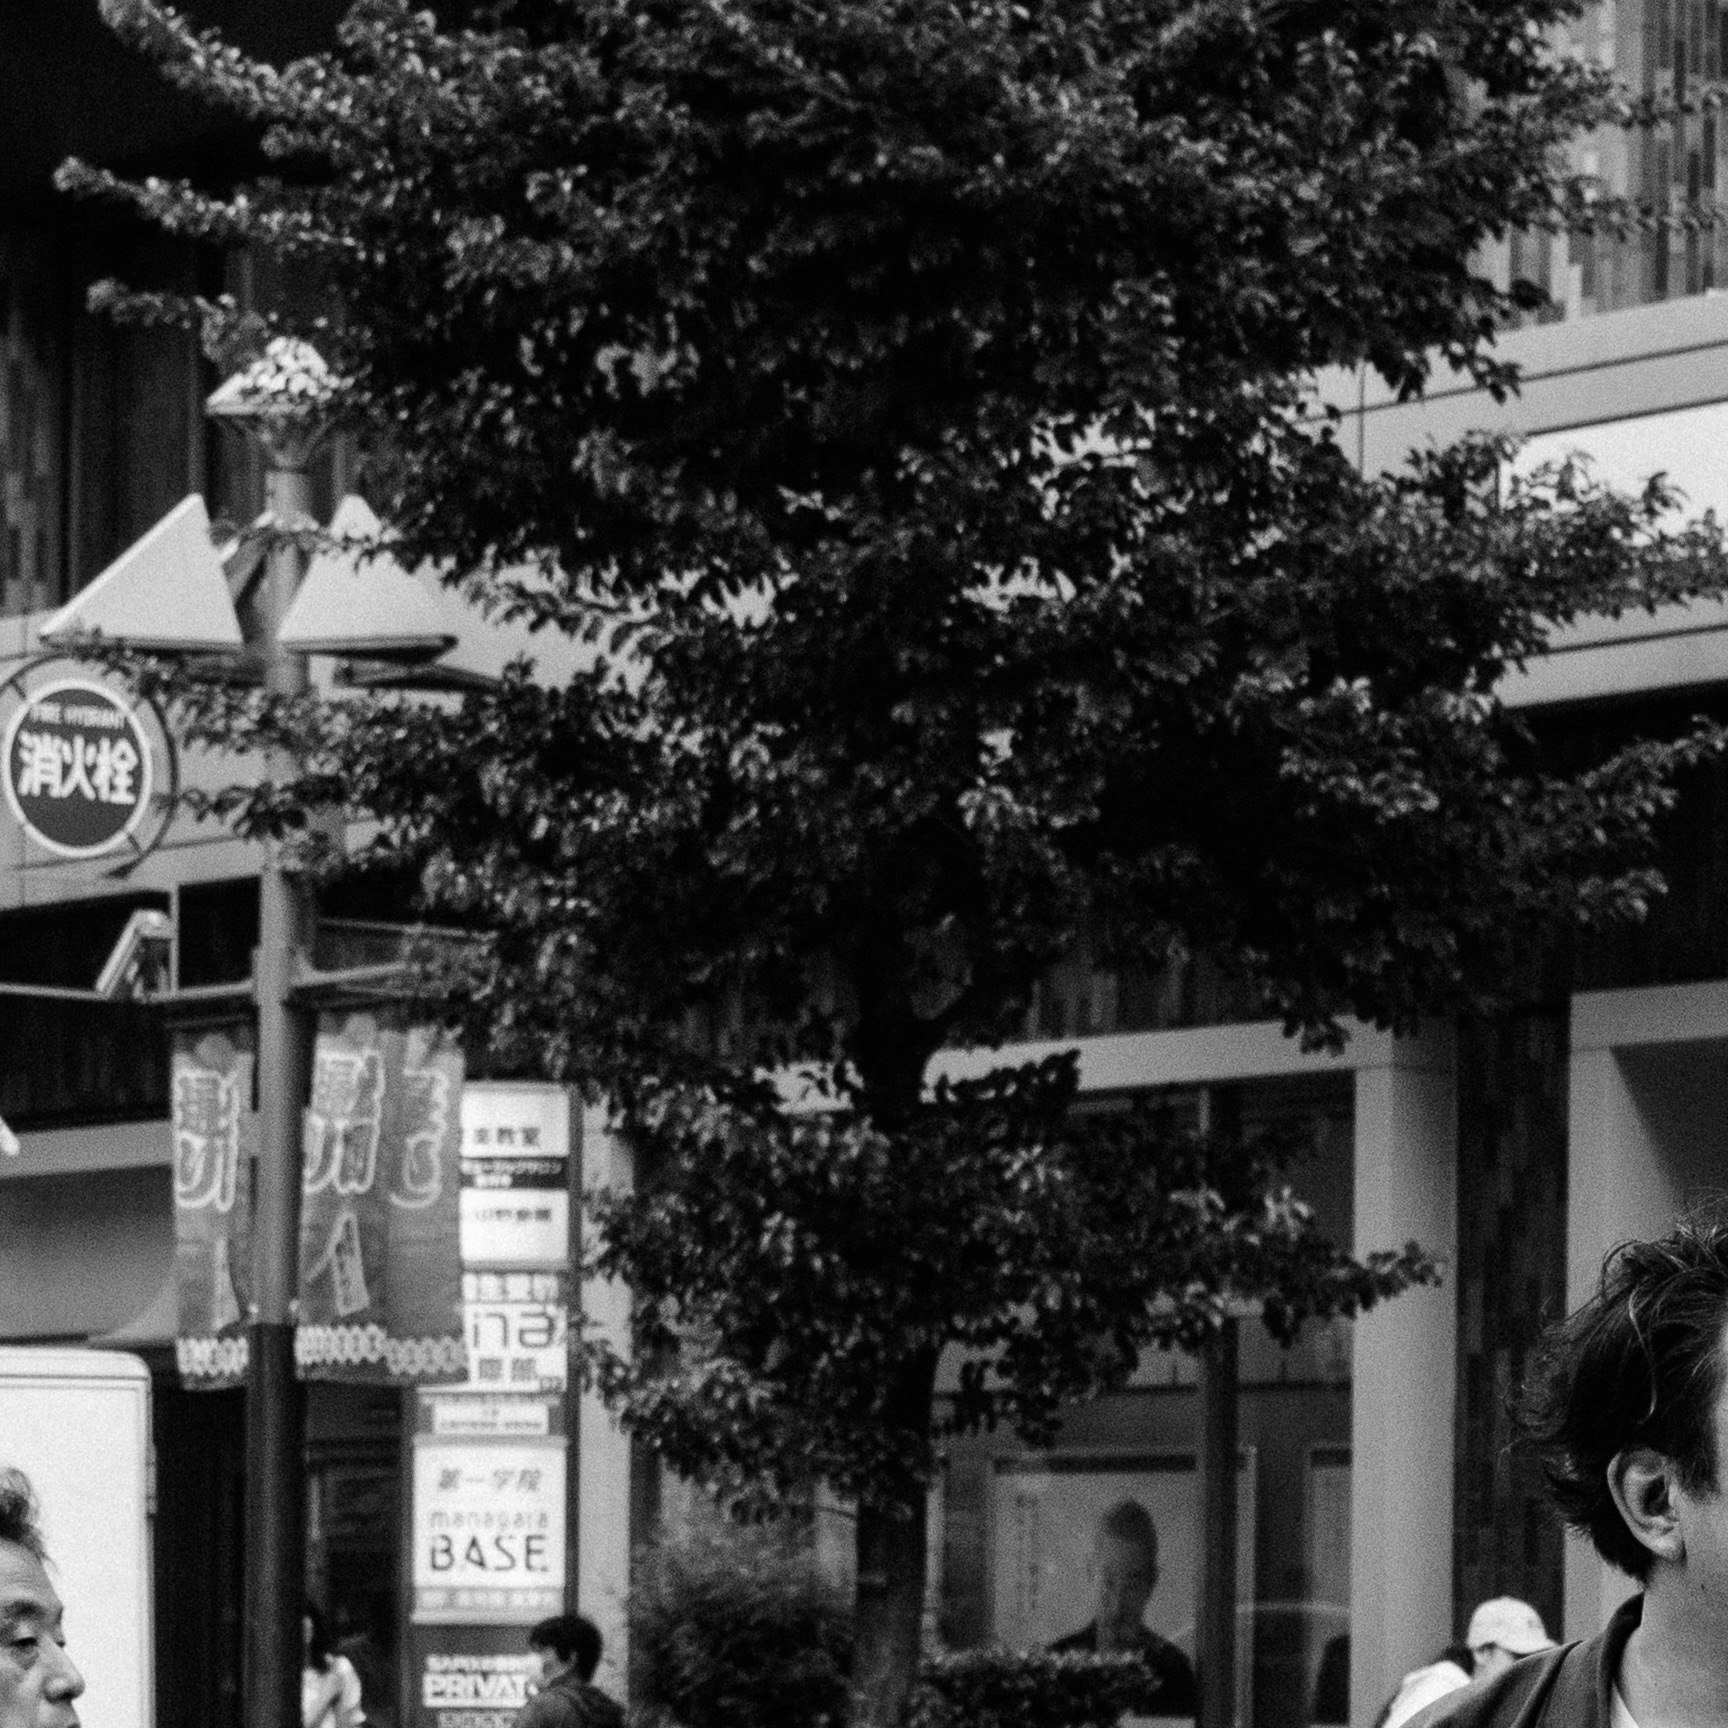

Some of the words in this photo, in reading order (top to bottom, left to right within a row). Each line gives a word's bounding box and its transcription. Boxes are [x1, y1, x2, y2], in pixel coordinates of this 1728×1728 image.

[18, 731, 138, 804] 消火栓
[430, 1533, 549, 1572] BASE
